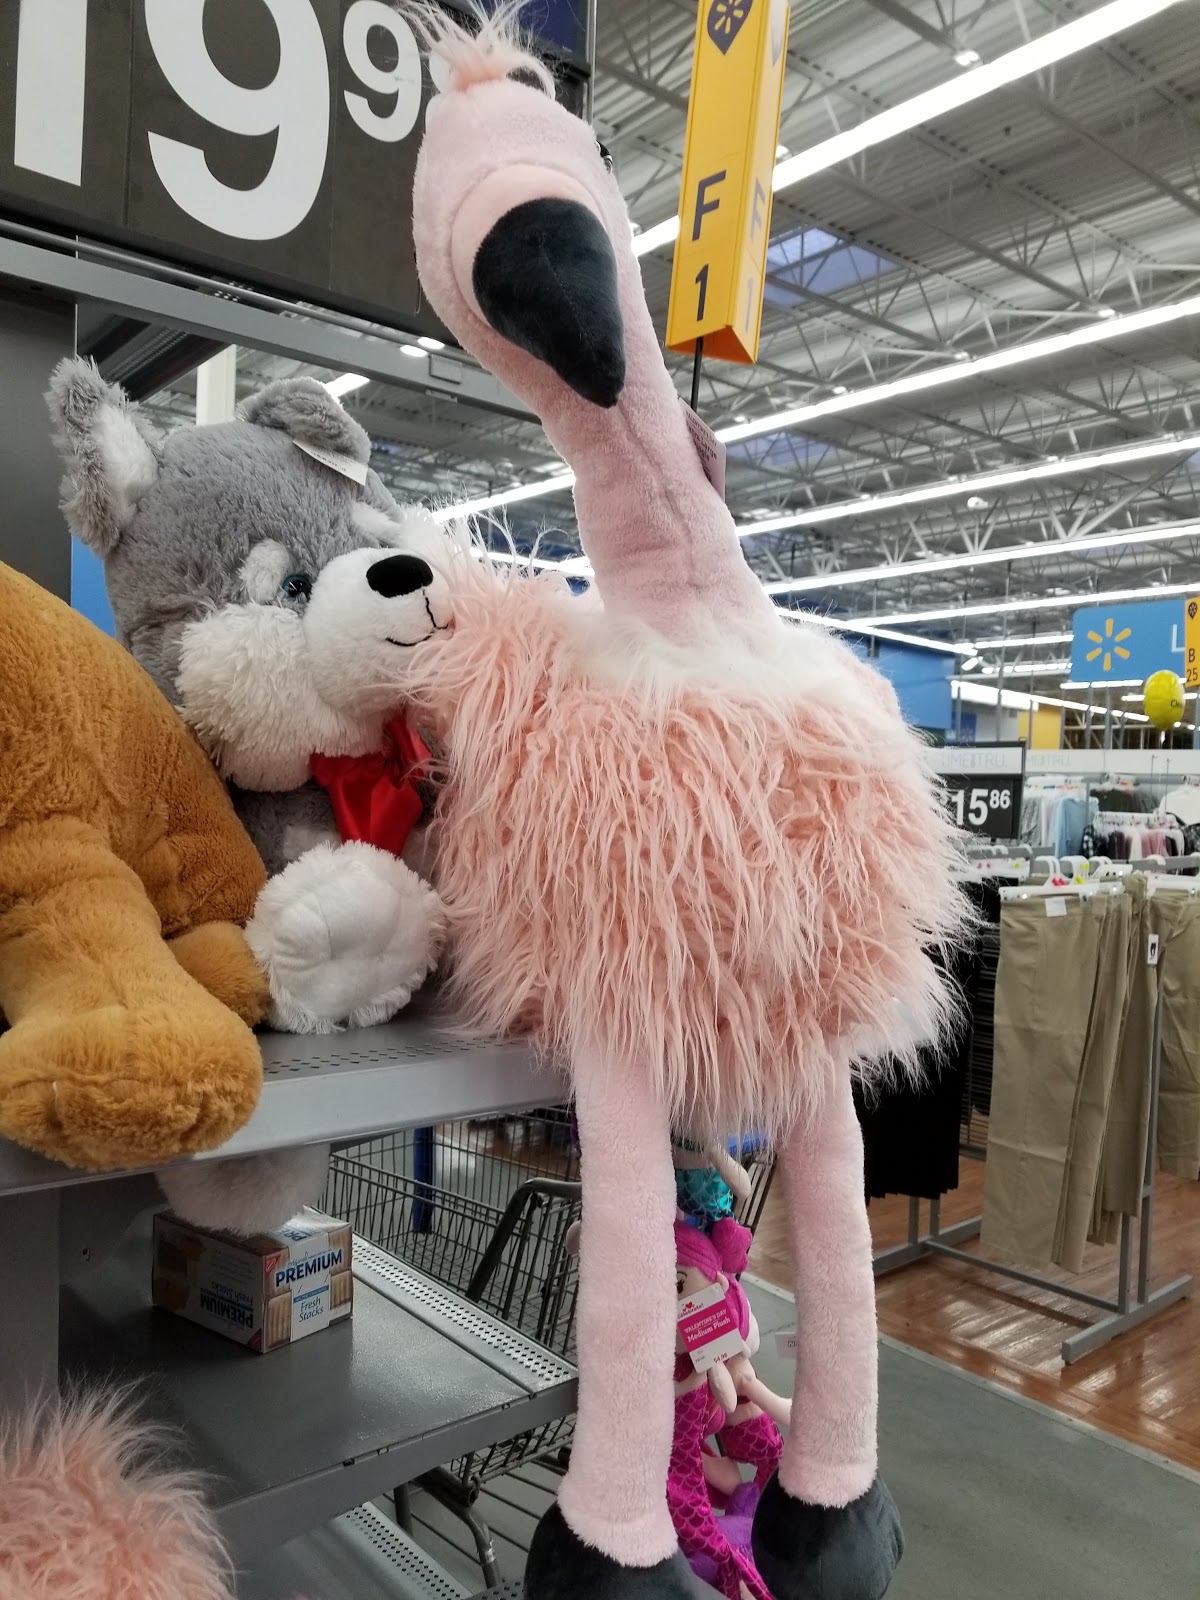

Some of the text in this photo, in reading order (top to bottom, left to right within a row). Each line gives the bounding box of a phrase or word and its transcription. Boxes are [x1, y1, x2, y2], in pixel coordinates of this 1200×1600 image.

[692, 169, 727, 241] F
[695, 263, 709, 322] 1
[1188, 648, 1196, 663] B
[1186, 667, 1199, 683] 25
[275, 1248, 343, 1287] PREMIUM
[200, 1292, 254, 1329] PREMIUM
[299, 1306, 325, 1323] Stacks
[300, 1296, 321, 1313] Fresh
[683, 1309, 728, 1334] VALENTINE'S DAY
[686, 1316, 731, 1343] Medium Plush
